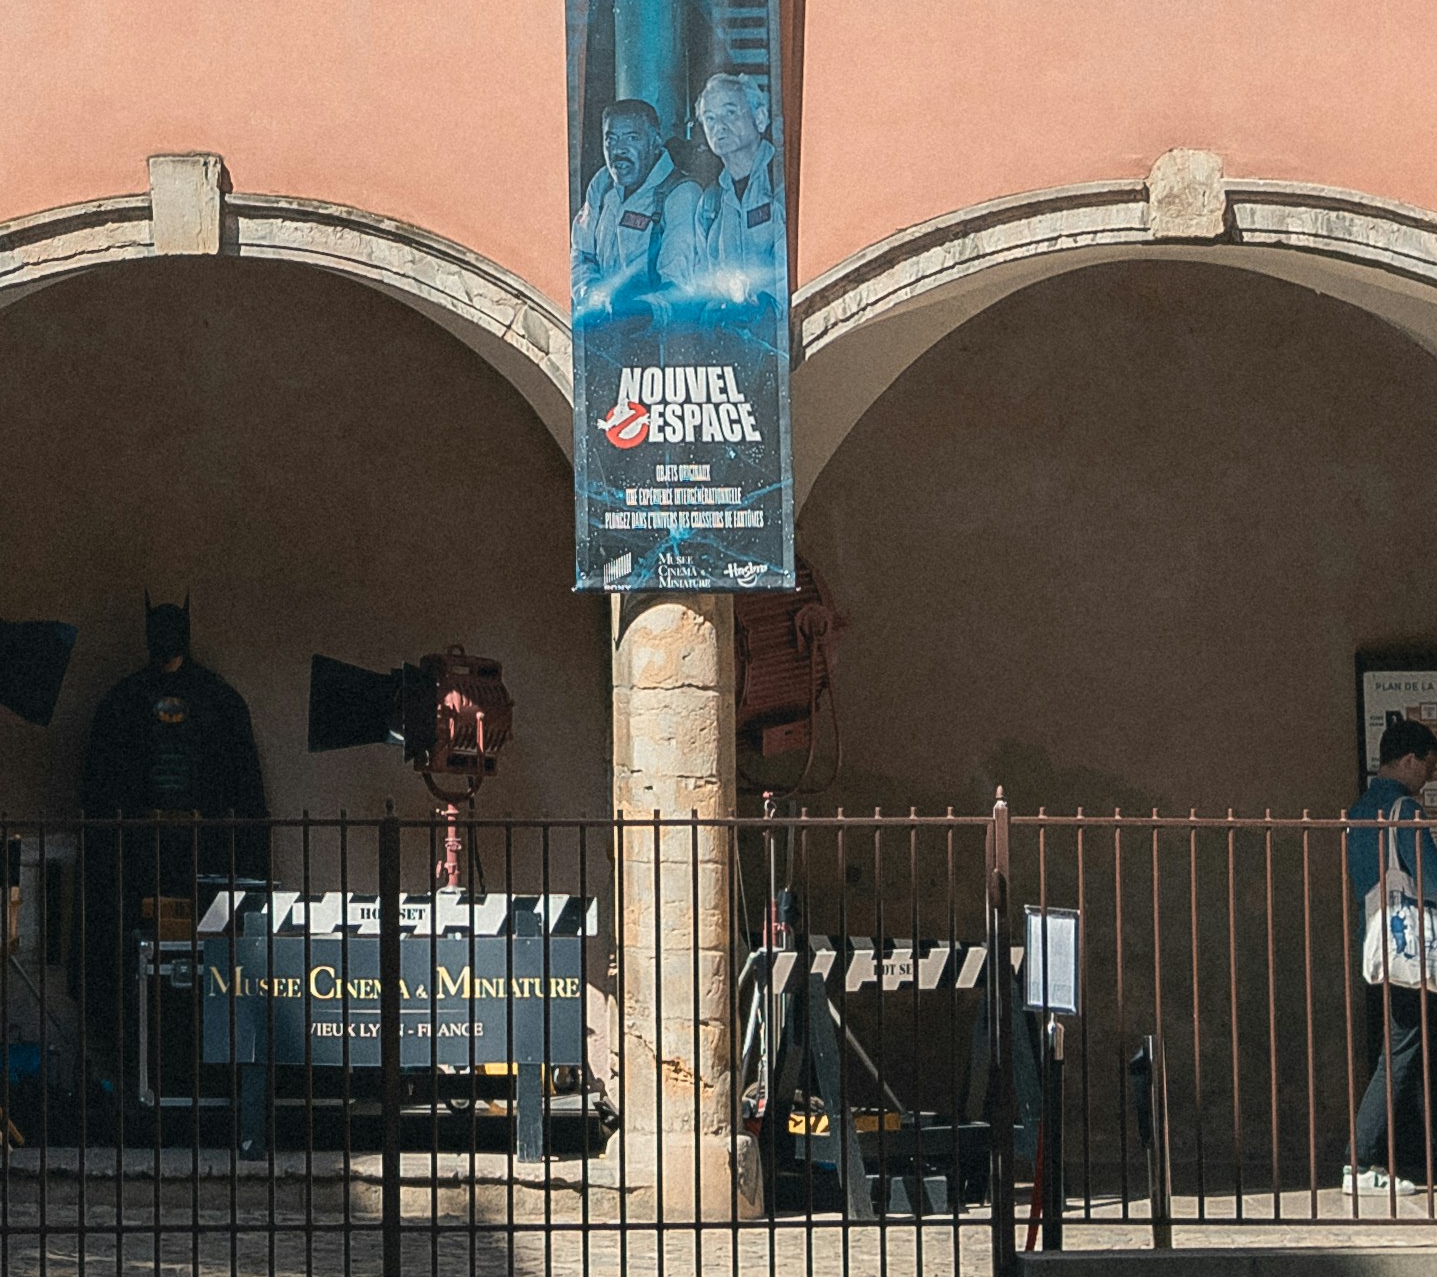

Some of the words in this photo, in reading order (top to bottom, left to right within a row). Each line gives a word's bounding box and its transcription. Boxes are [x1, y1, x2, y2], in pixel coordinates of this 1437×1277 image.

[617, 366, 745, 403] NOUVEL
[648, 403, 762, 443] ESPACE
[656, 464, 678, 482] OBJETS
[632, 512, 647, 529] DANS
[679, 511, 690, 528] DES
[691, 511, 724, 528] CHASSEURS
[725, 511, 732, 528] DE
[658, 565, 697, 577] CINEMA
[723, 561, 768, 578] Hasbro
[658, 577, 711, 588] MINIATURE
[1375, 682, 1402, 691] PLAN
[1405, 682, 1419, 691] DE
[1421, 682, 1435, 691] LA
[360, 907, 380, 920] HO
[399, 908, 425, 920] SET
[899, 963, 914, 975] SE
[209, 965, 301, 997] MUSEE
[415, 983, 428, 999] &
[436, 965, 580, 999] MINIATURE
